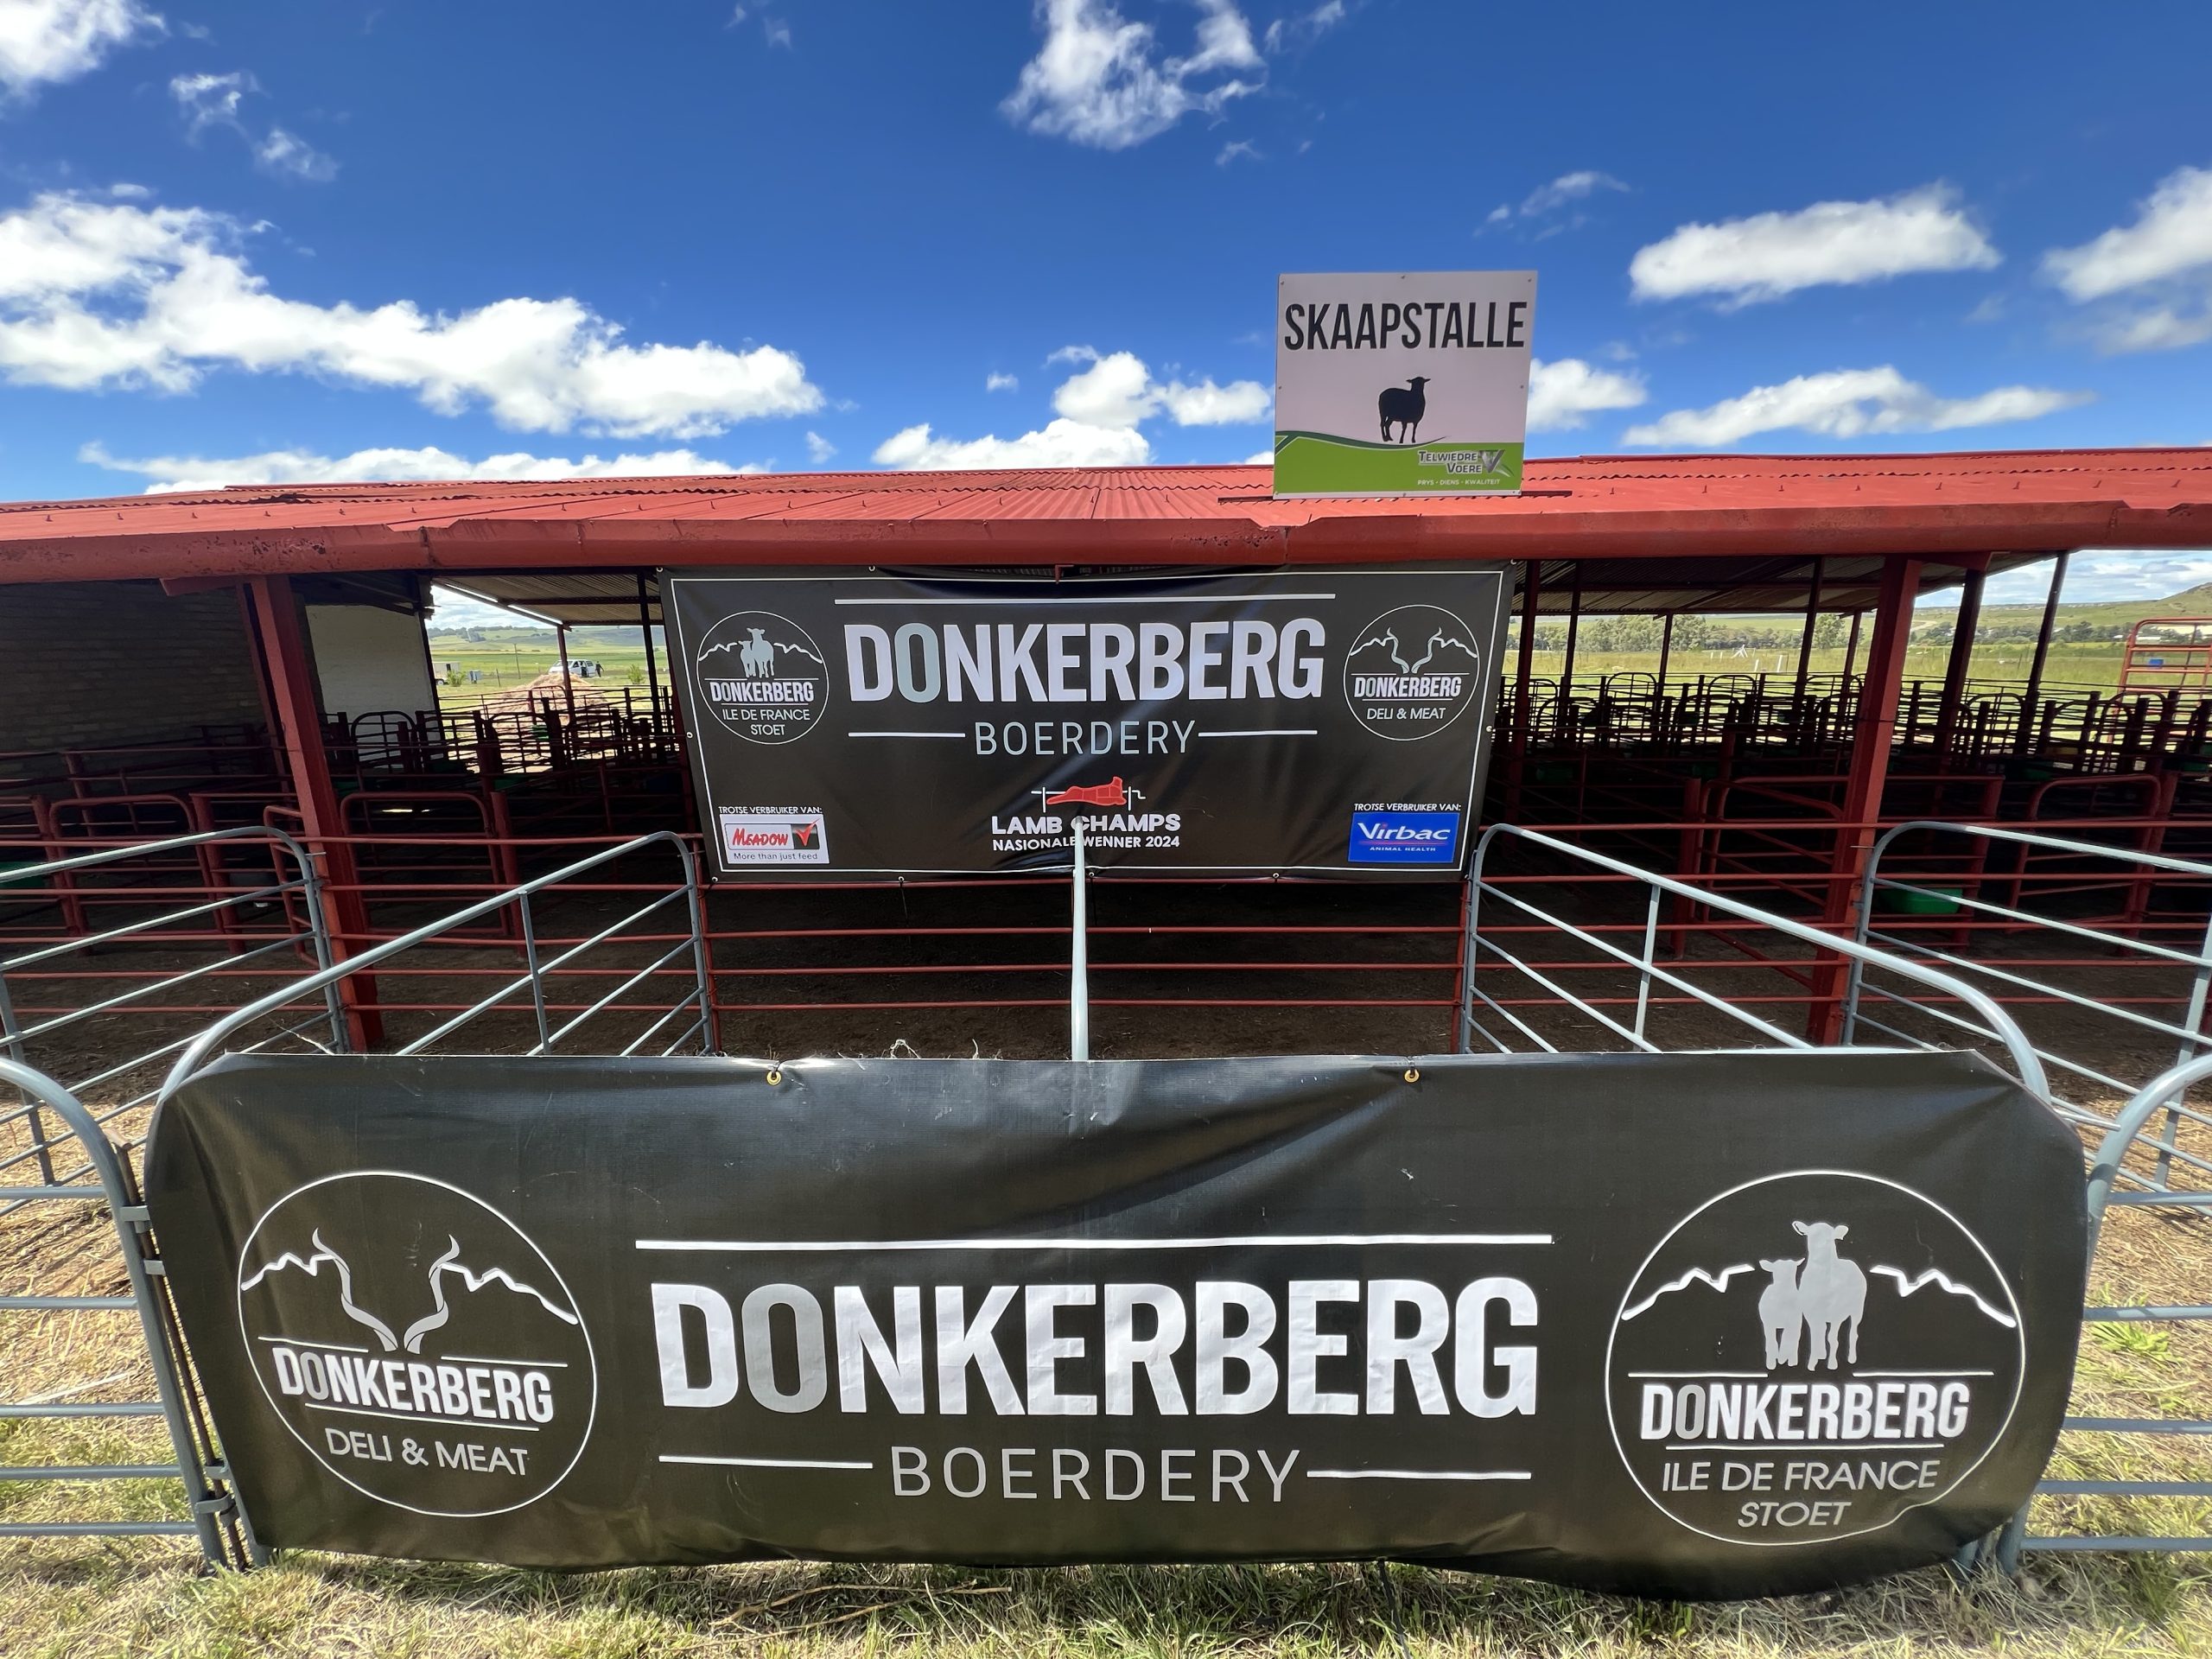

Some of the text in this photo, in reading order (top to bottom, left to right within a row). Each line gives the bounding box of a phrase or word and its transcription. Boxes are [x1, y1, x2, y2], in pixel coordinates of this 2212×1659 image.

[1284, 302, 1528, 350] SKAAPSTALLE
[1418, 450, 1478, 462] TELWIEDRE
[1446, 462, 1483, 474] VOERE
[843, 618, 1325, 703] DONKERBERG
[709, 681, 815, 702] DONKERBERG
[1353, 676, 1462, 697] DONKERBERG
[722, 709, 810, 721] ILE DE FRANCE
[1366, 707, 1446, 720] DELI & MEAT
[750, 724, 785, 735] STOET
[975, 720, 1196, 756] BOERDERY
[991, 813, 1181, 835] LAMB CHAMPS
[1357, 822, 1451, 840] Virbac
[732, 828, 789, 846] MEADOW
[993, 836, 1180, 851] NASIONALE WENNER 2024
[651, 1277, 1540, 1419] DONKERBERG
[272, 1347, 554, 1424] DONKERBERG
[1641, 1382, 1970, 1440] DONKERBERG
[324, 1427, 529, 1476] DELI & MEAT
[892, 1446, 1300, 1503] BOERDERY
[1662, 1460, 1942, 1492] ILE DE FRANCE
[1737, 1502, 1852, 1528] STOET
